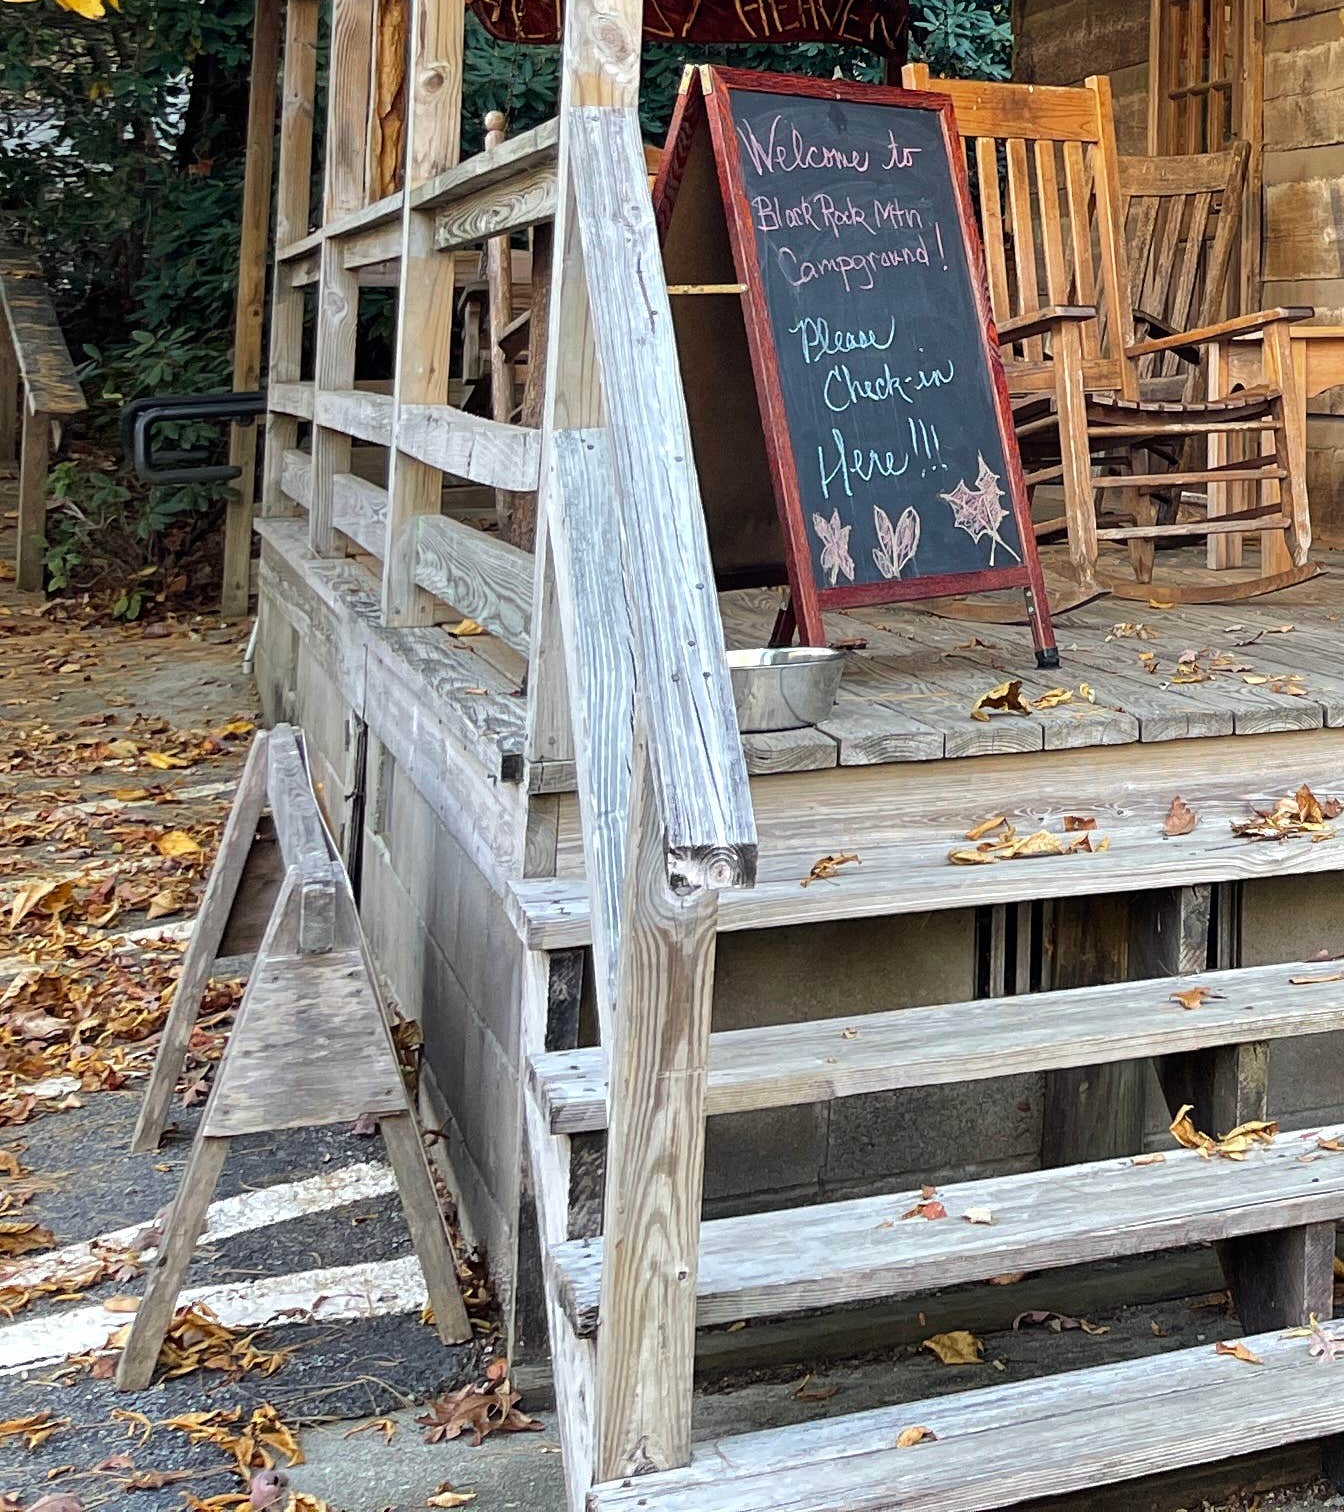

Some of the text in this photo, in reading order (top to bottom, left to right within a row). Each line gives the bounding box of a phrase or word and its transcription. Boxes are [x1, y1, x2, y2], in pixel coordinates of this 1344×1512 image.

[736, 115, 922, 175] Welcome to
[752, 194, 821, 232] Black
[813, 193, 877, 238] Rock
[788, 315, 895, 364] Please
[824, 347, 954, 412] Check-in
